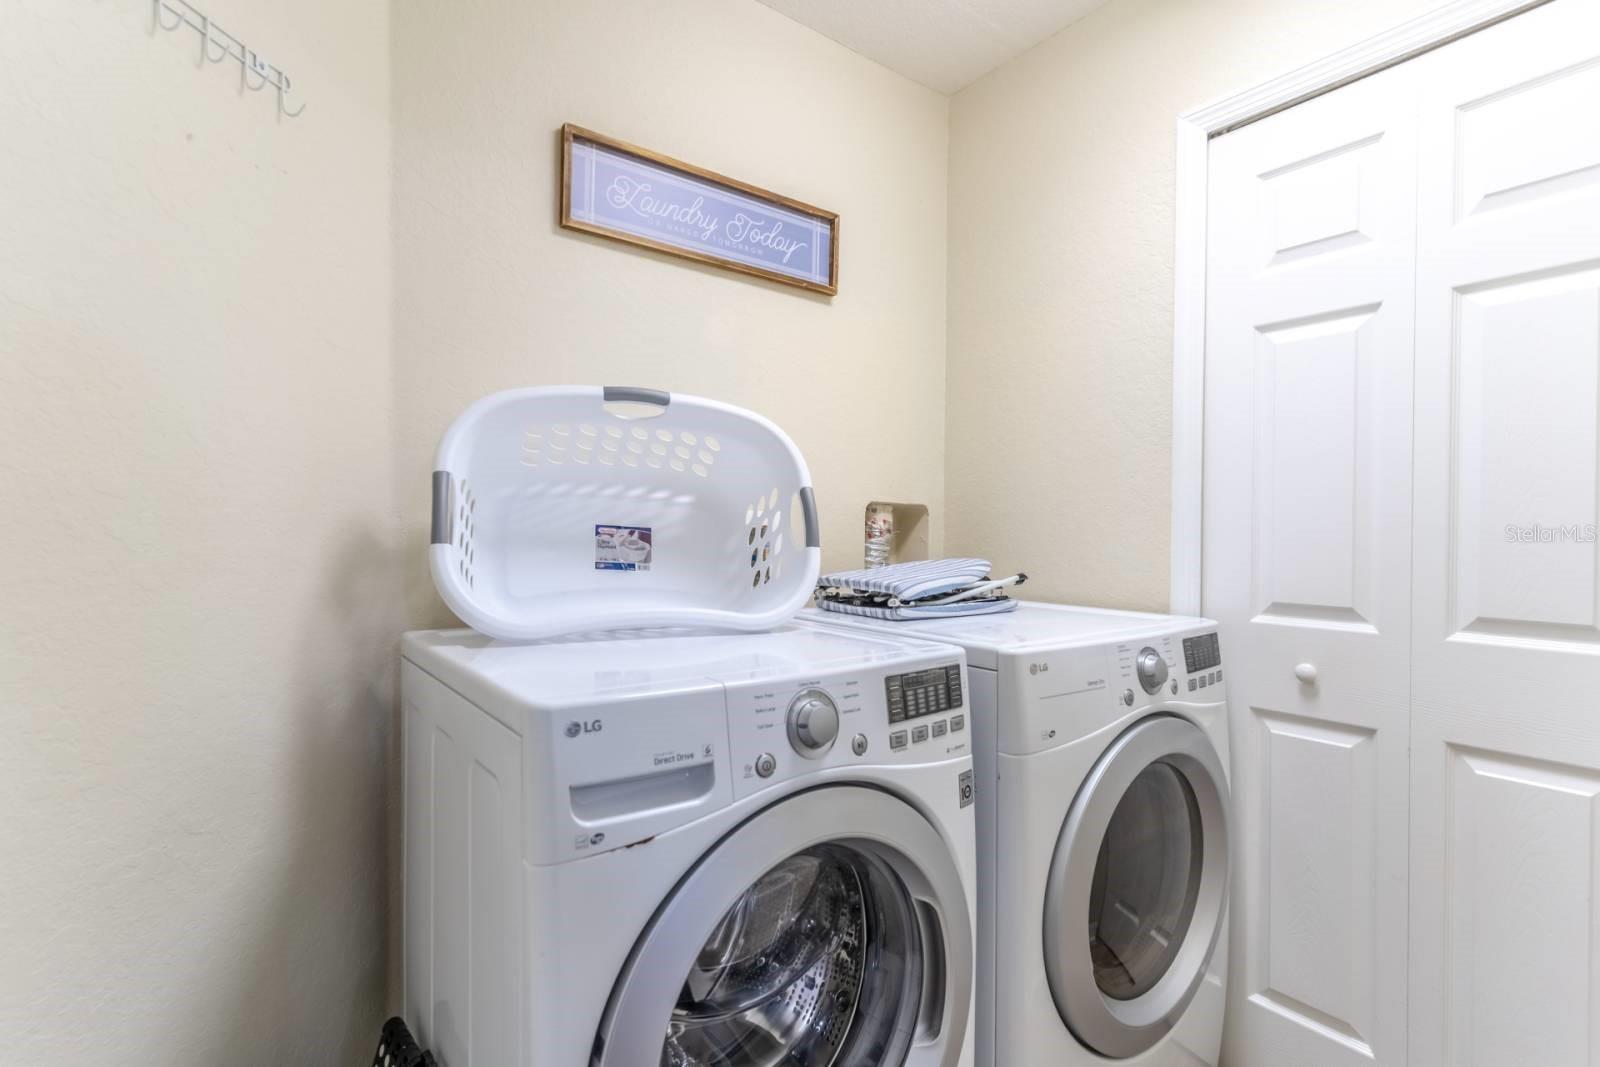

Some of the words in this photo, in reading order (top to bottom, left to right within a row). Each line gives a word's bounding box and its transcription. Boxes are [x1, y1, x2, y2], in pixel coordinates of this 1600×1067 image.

[606, 175, 719, 241] Laundry
[726, 213, 809, 264] Today
[1038, 663, 1048, 672] LG
[584, 719, 602, 733] LG
[653, 755, 676, 766] Direct
[676, 752, 694, 762] Drive
